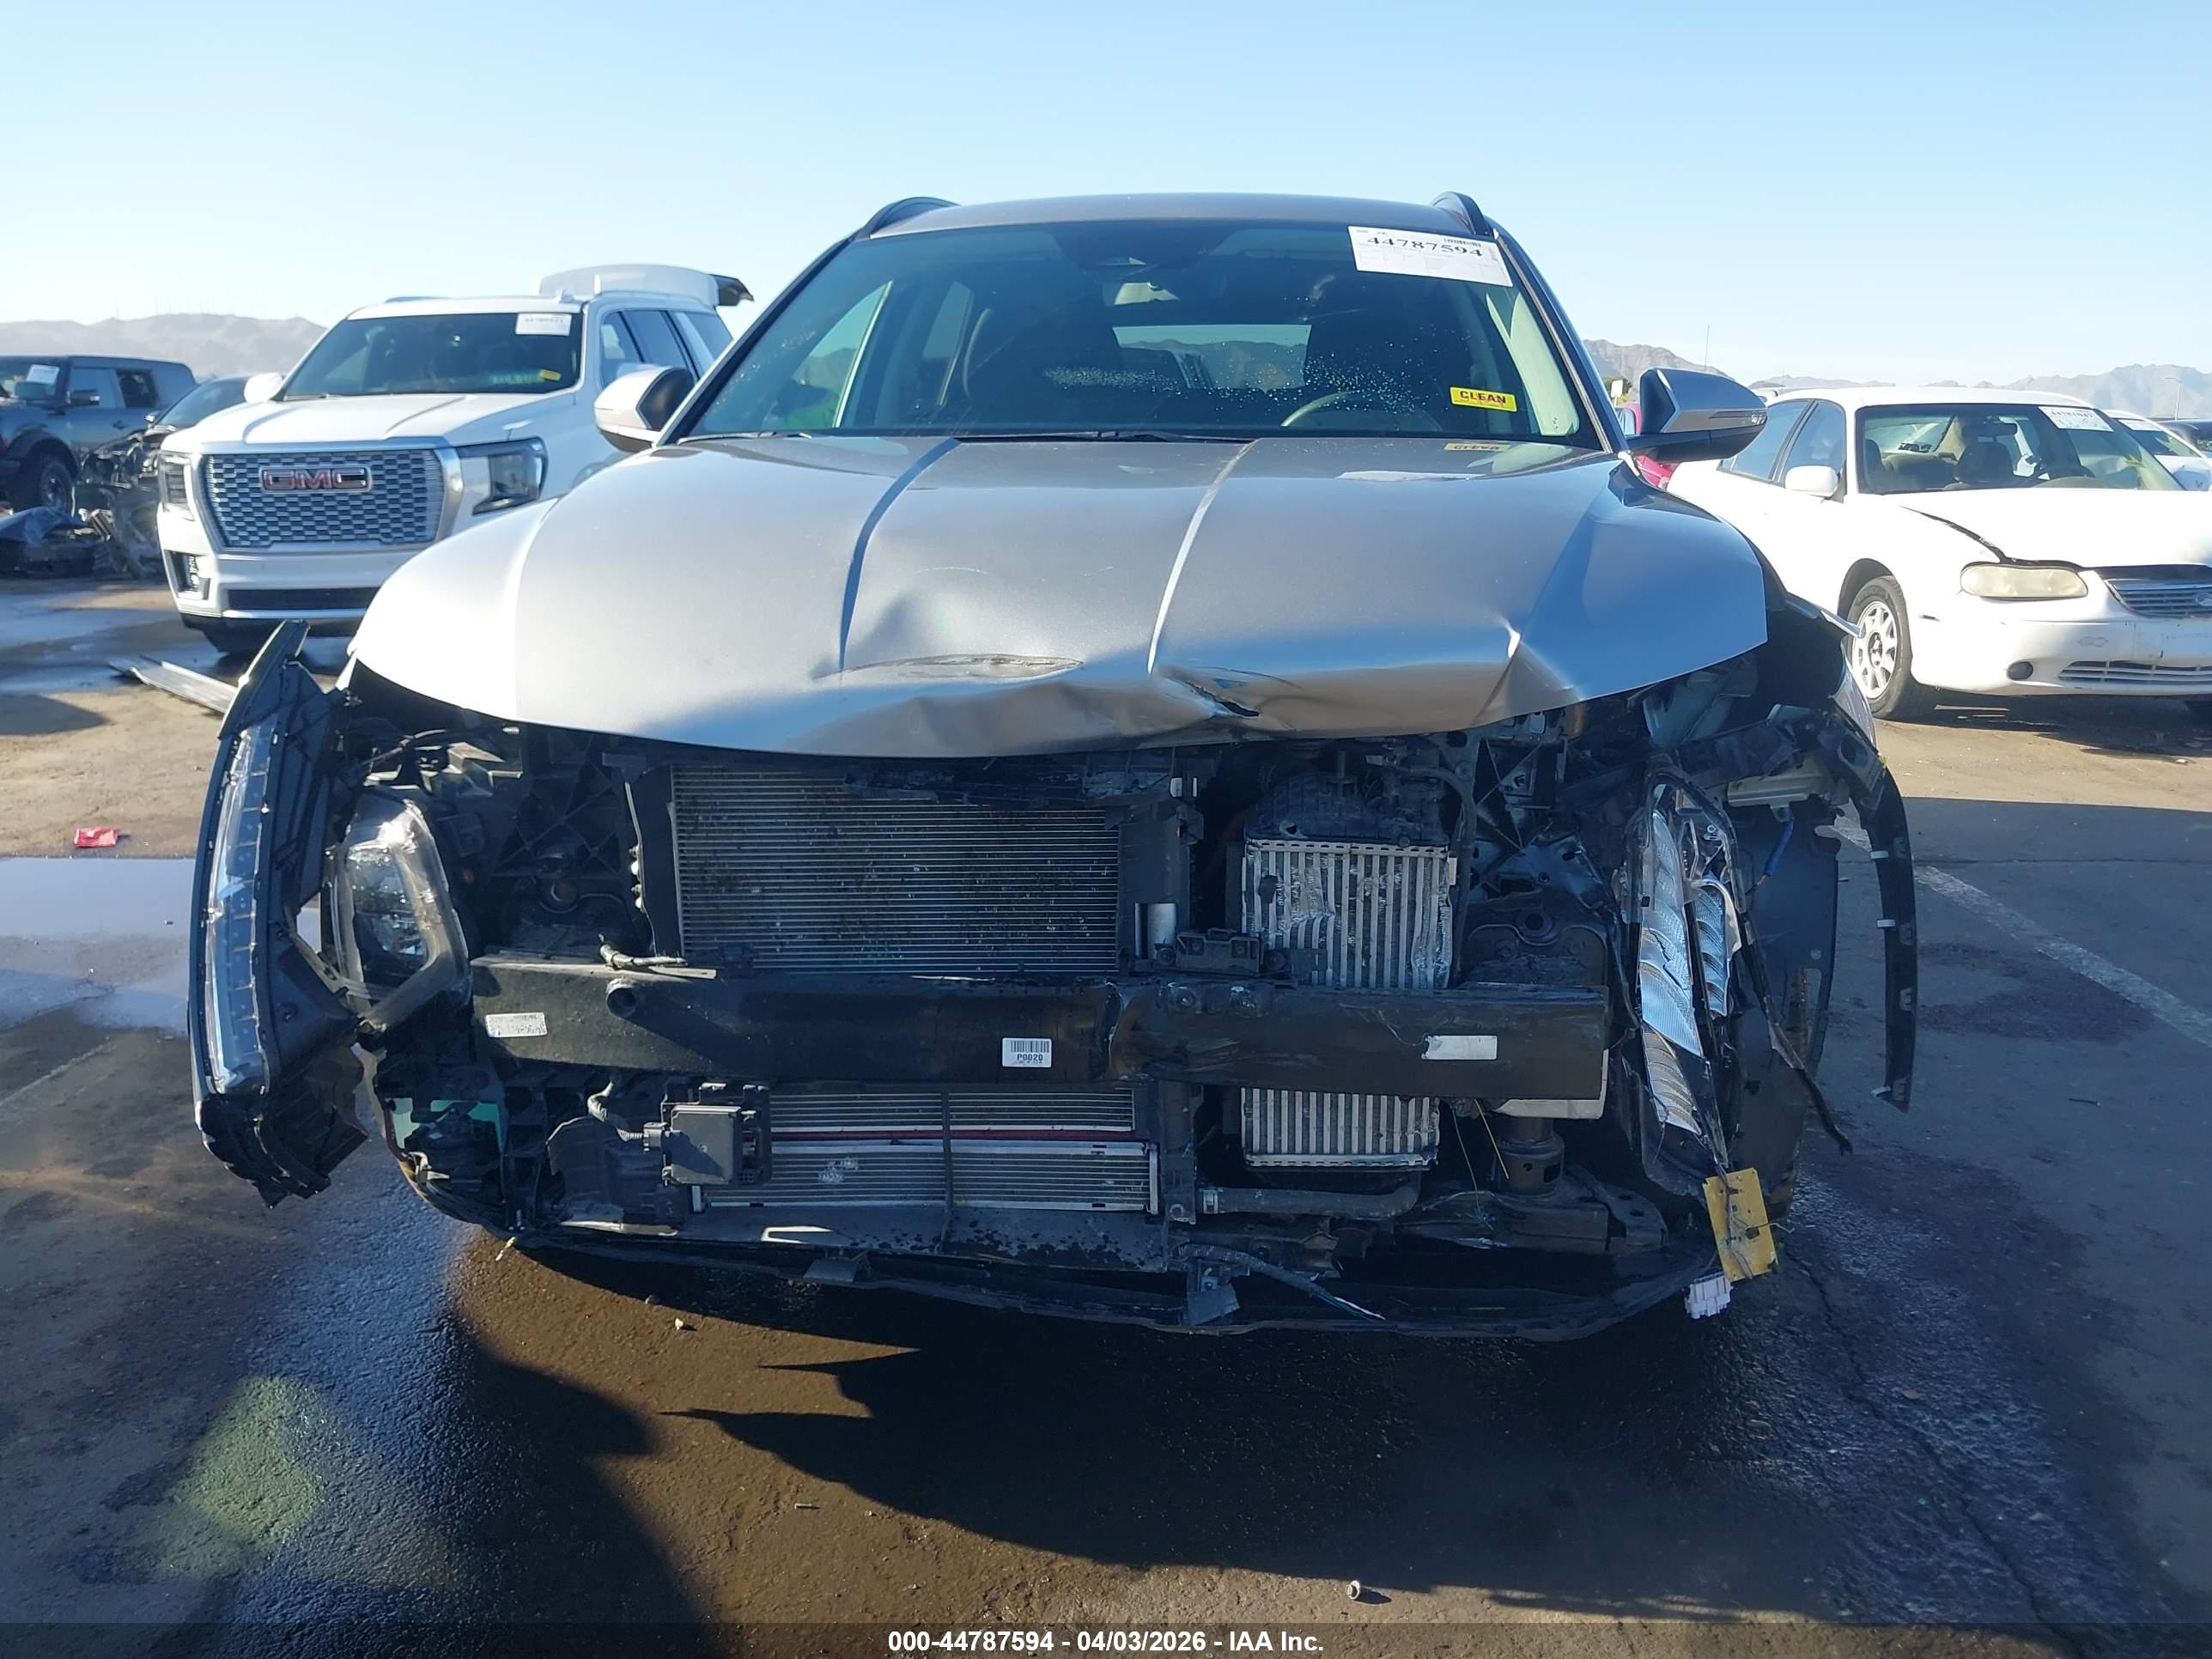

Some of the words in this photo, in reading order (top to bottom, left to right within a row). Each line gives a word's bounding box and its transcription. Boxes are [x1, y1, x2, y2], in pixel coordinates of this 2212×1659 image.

[1367, 236, 1484, 257] 44787594
[1460, 391, 1506, 404] CLEAN
[263, 468, 368, 490] GMC
